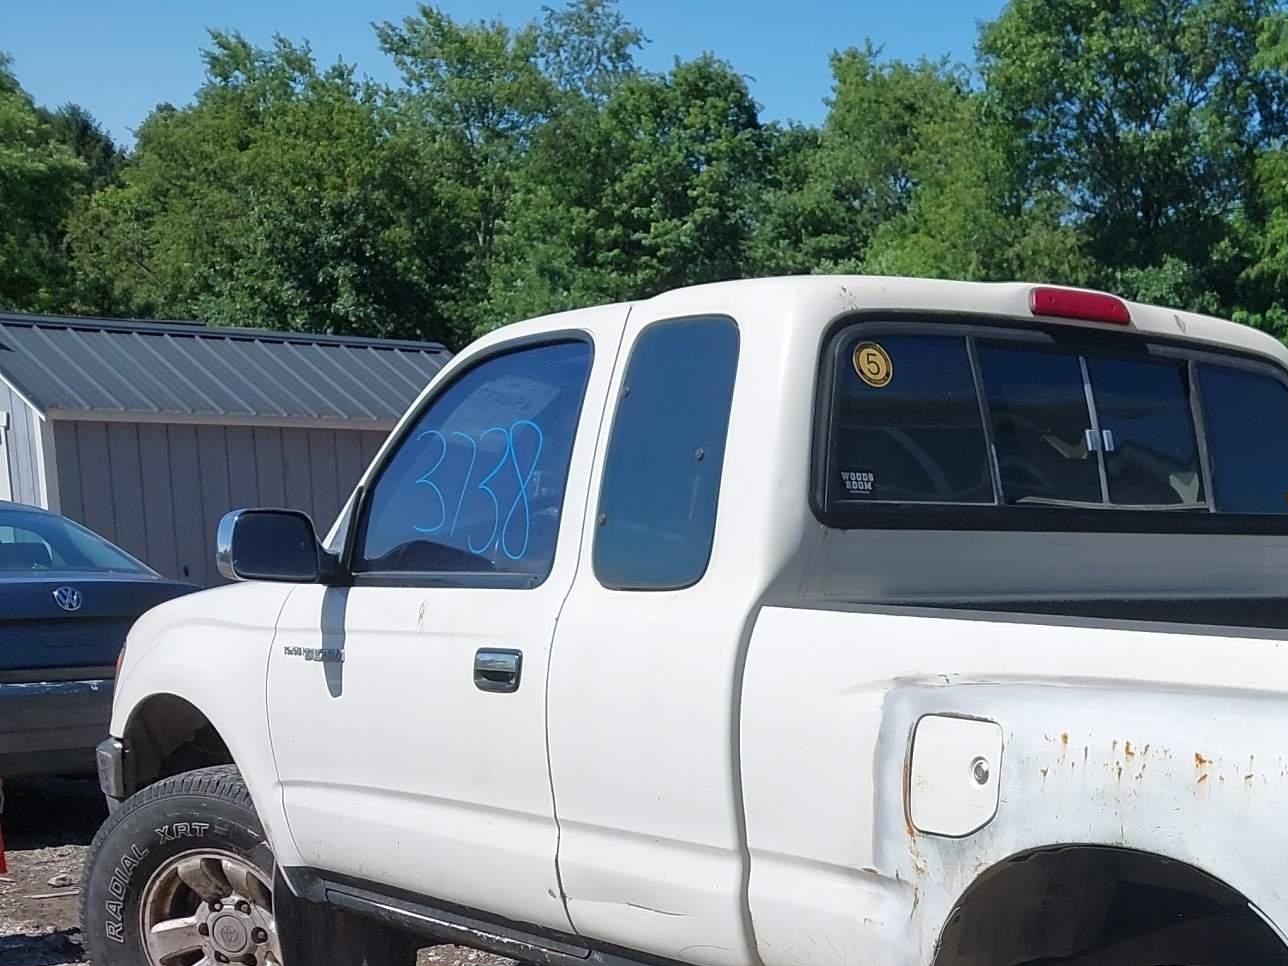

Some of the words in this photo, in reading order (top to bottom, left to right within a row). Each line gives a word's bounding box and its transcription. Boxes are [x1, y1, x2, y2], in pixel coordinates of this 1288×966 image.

[866, 352, 881, 376] 5
[413, 420, 543, 560] 3738
[105, 843, 151, 944] RADIAL
[154, 821, 210, 845] XRT
